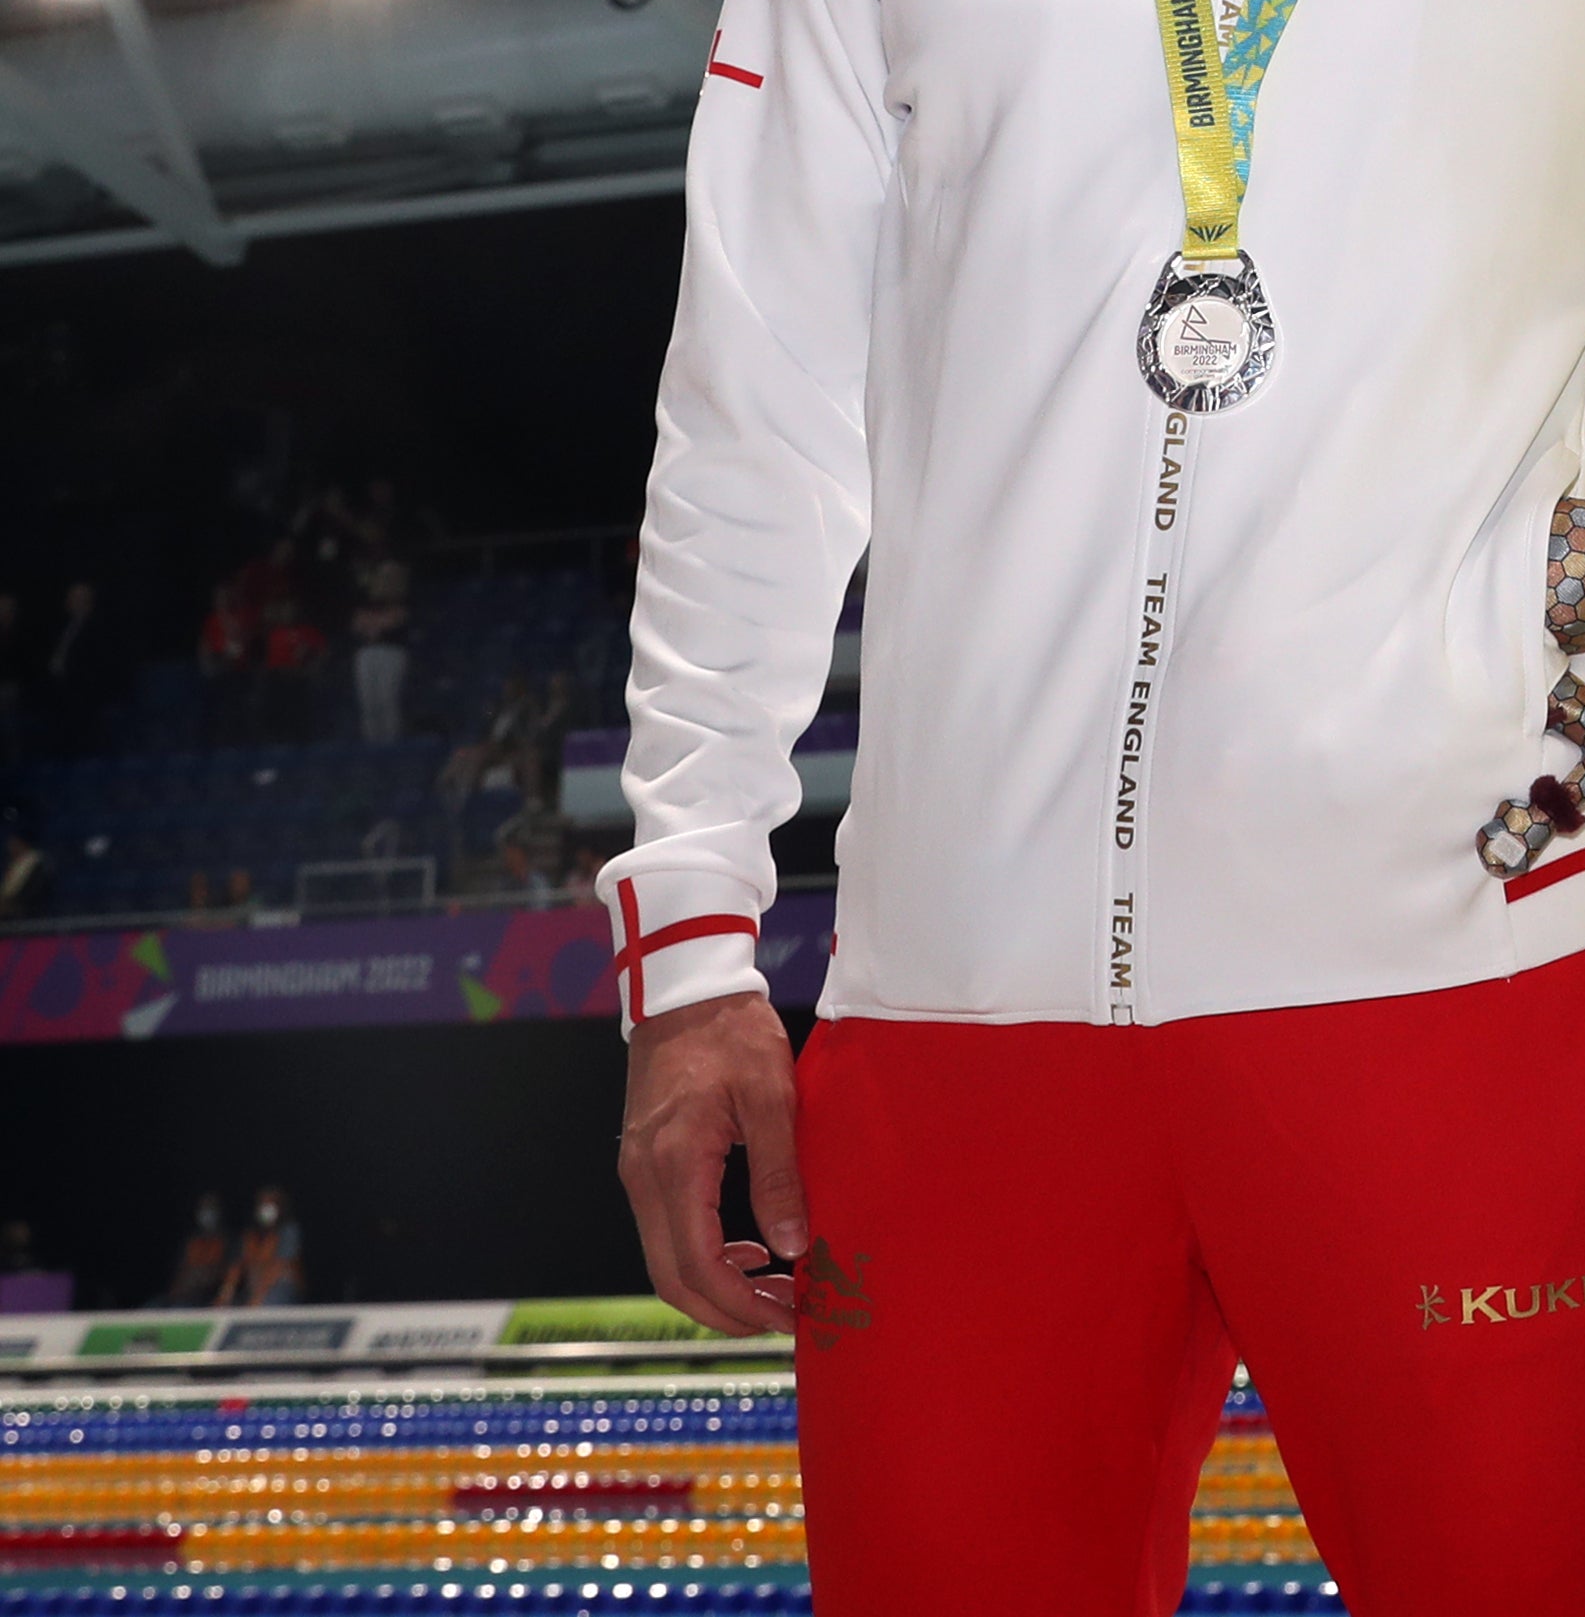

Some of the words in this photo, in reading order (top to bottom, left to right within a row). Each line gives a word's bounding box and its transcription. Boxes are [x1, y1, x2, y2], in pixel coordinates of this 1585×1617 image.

[1173, 343, 1238, 356] BIRMINGHAM
[1192, 356, 1218, 366] 2022
[1154, 412, 1188, 531] GLAND
[1137, 573, 1168, 667] TEAM
[1114, 681, 1152, 851] ENGLAND
[1110, 892, 1135, 989] TEAM
